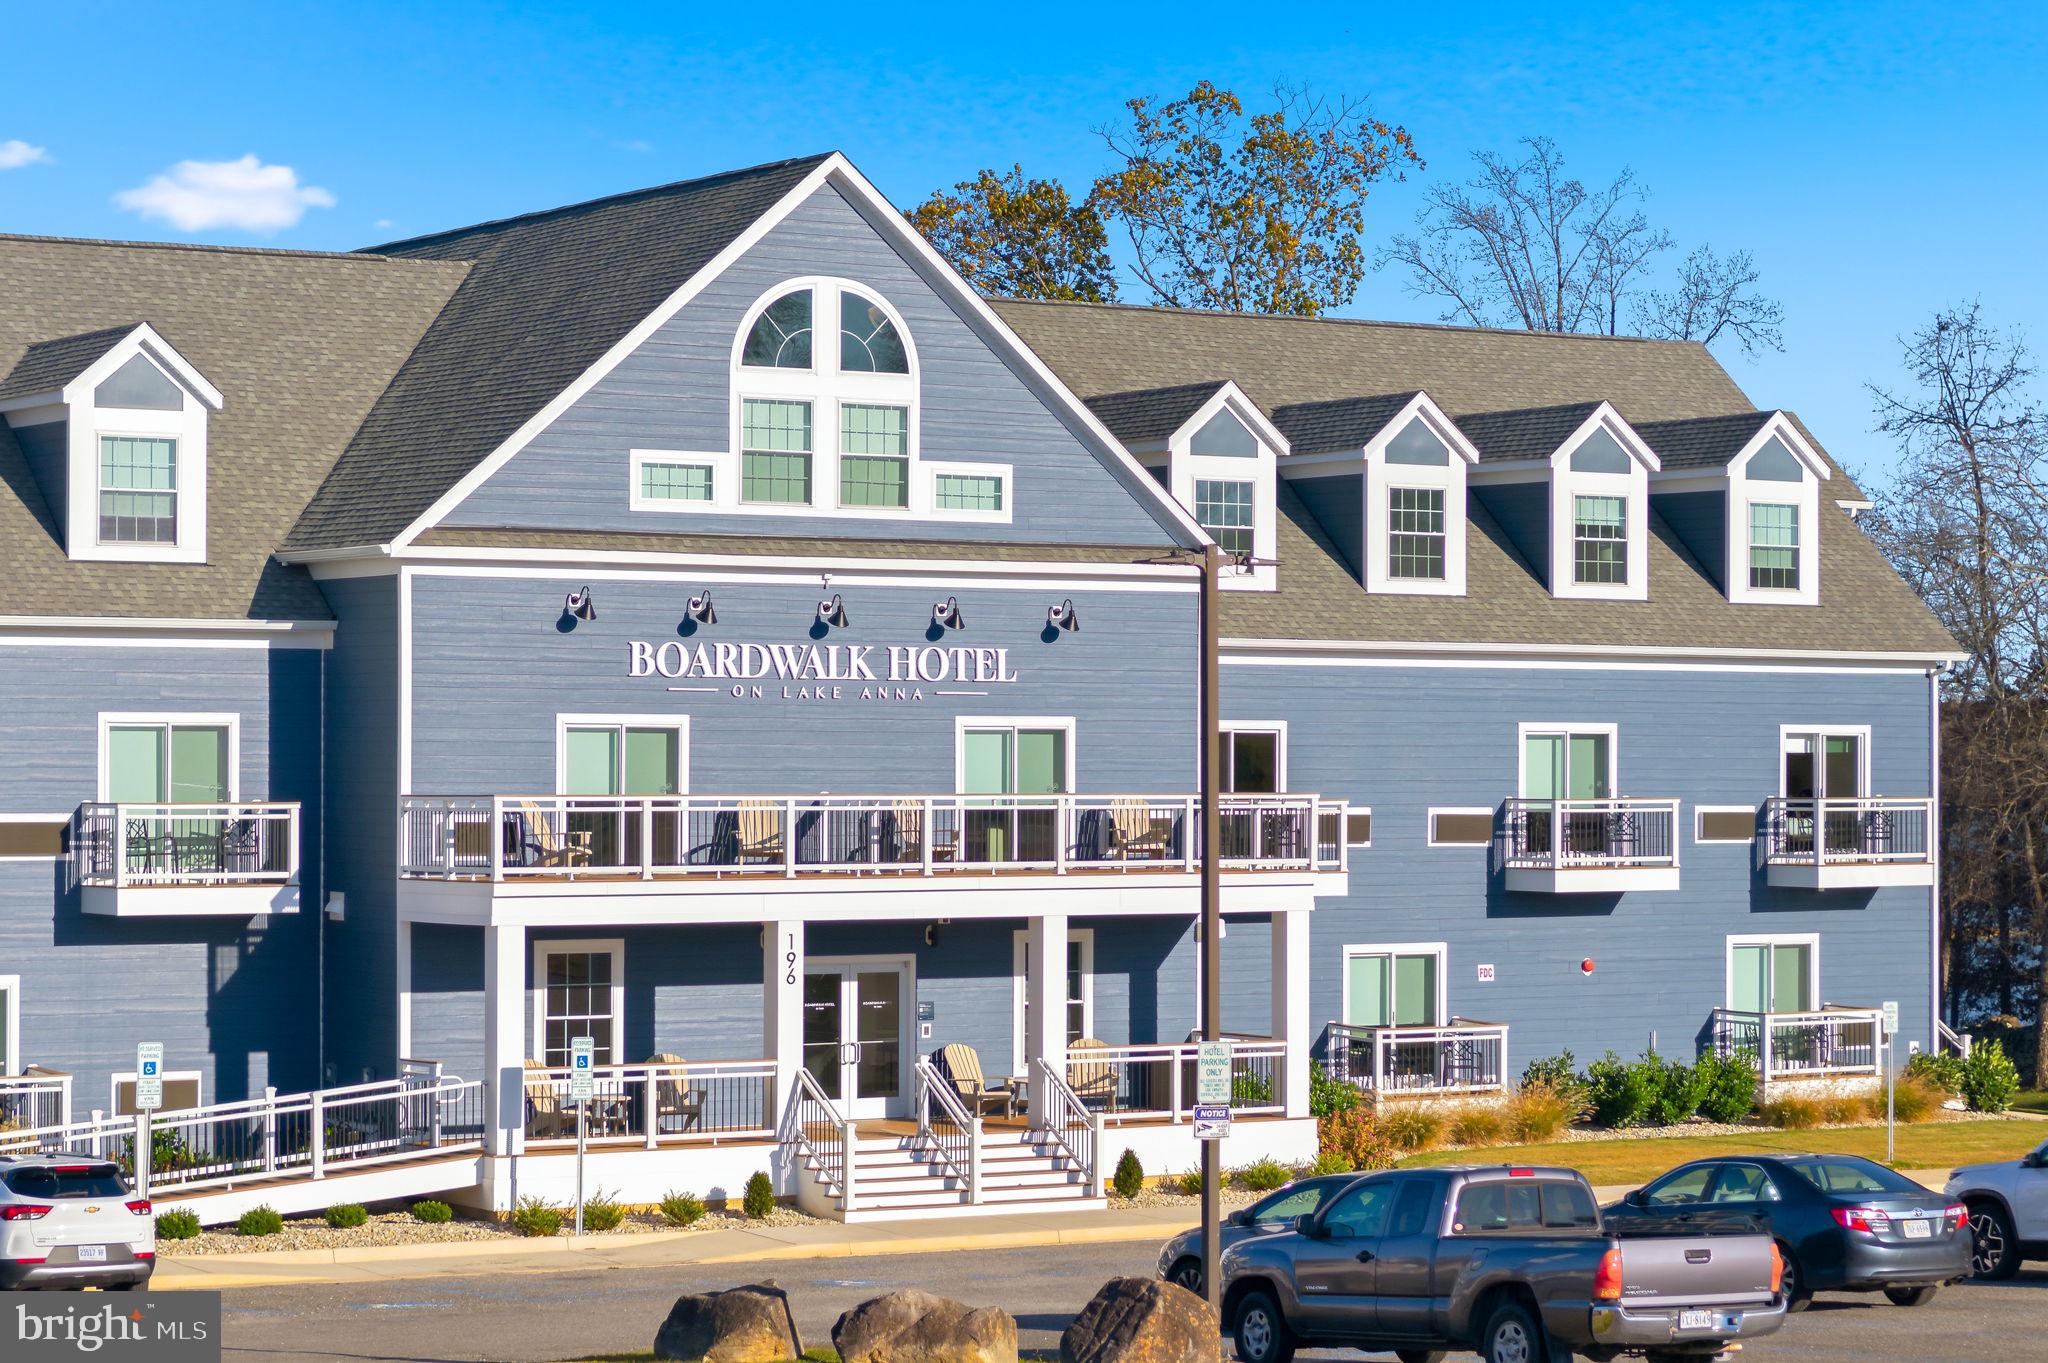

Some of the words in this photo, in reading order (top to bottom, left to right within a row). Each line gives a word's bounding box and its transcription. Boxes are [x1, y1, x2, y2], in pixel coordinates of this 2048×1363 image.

[627, 641, 877, 680] BOARDWALK
[886, 646, 1018, 682] HOTEL
[731, 684, 762, 698] ON
[782, 685, 841, 699] LAKE
[859, 686, 923, 700] ANNA
[786, 933, 796, 985] 196
[1479, 967, 1493, 978] FDC
[1204, 1047, 1225, 1056] HOTEL
[1200, 1058, 1229, 1066] PARKING
[1206, 1068, 1223, 1077] ONLY
[1200, 1109, 1227, 1118] NOTICE
